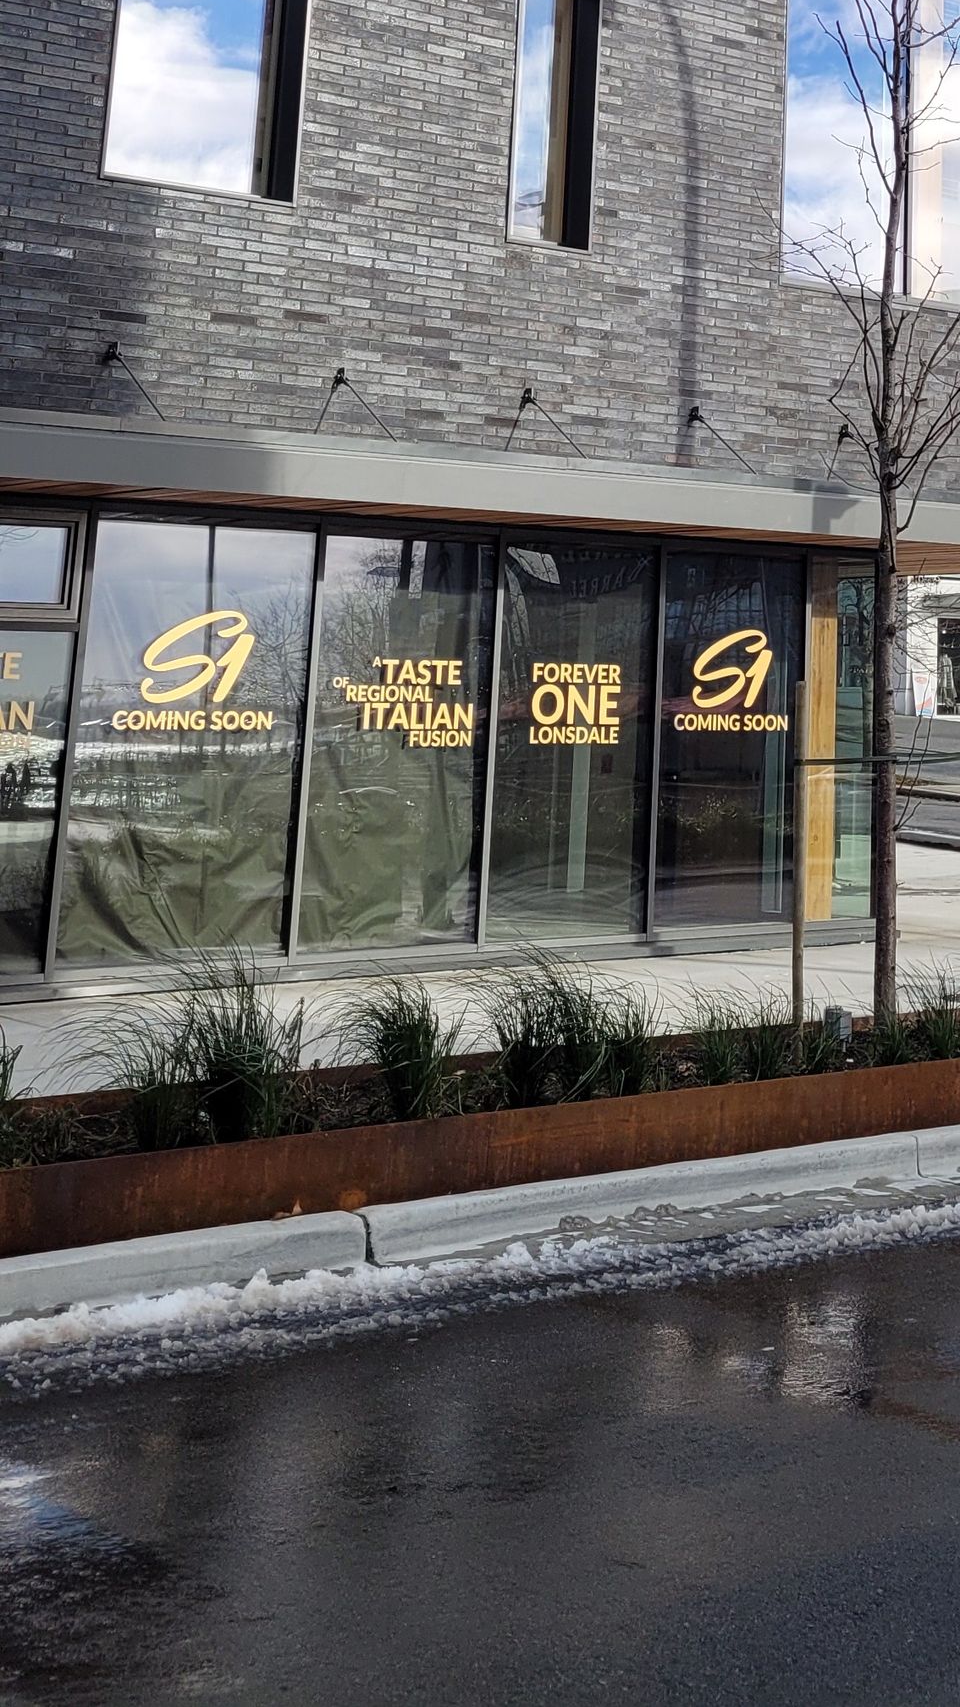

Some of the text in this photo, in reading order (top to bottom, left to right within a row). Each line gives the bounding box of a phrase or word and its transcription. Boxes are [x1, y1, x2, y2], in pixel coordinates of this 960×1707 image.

[372, 656, 463, 685] A TASTE
[532, 662, 621, 684] FOREVER
[332, 676, 434, 702] OF REGIONAL
[531, 683, 621, 725] ONE
[111, 709, 273, 731] COMING SOON
[362, 702, 474, 730] ITALIAN
[673, 713, 789, 732] COMING SOON
[409, 730, 472, 748] FUSION
[529, 726, 620, 745] LONSDALE
